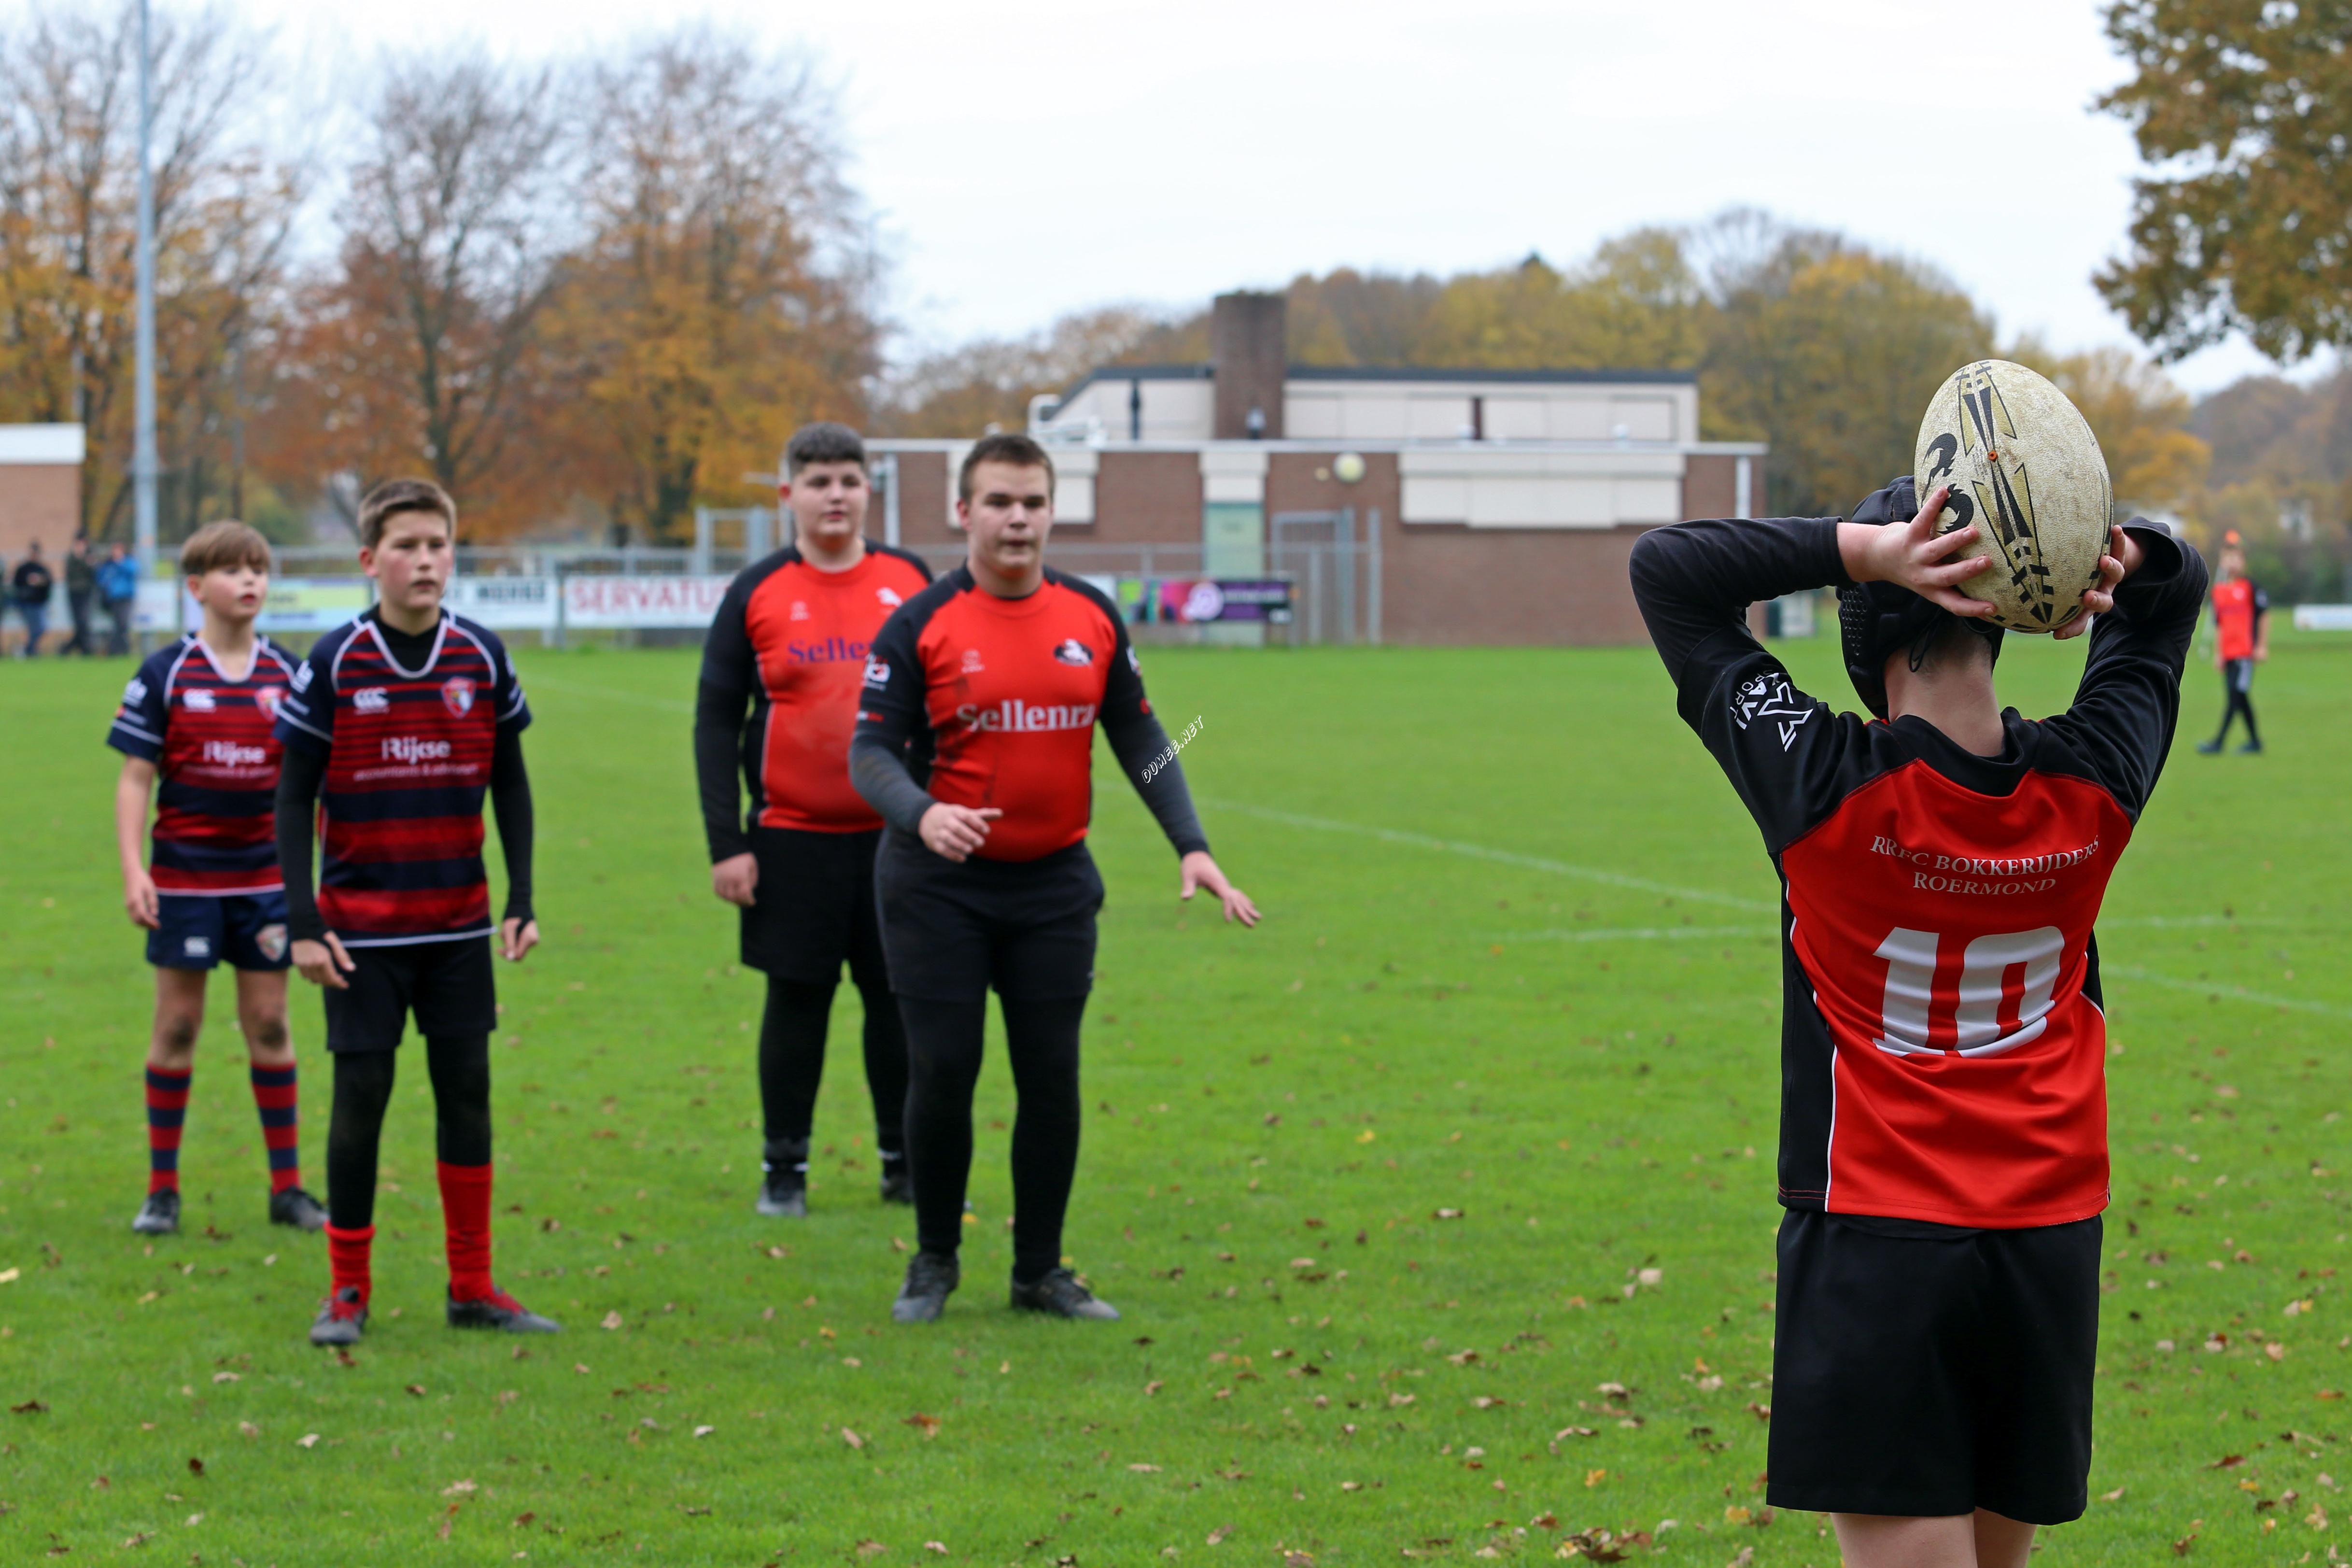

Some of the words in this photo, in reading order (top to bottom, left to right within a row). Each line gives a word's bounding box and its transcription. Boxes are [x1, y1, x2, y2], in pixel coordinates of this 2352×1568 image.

[1870, 835, 1929, 865] RRFC
[1933, 834, 2099, 876] BOKKERIJDERS
[1913, 871, 2056, 895] ROERMOND
[1873, 925, 2065, 1059] 10
